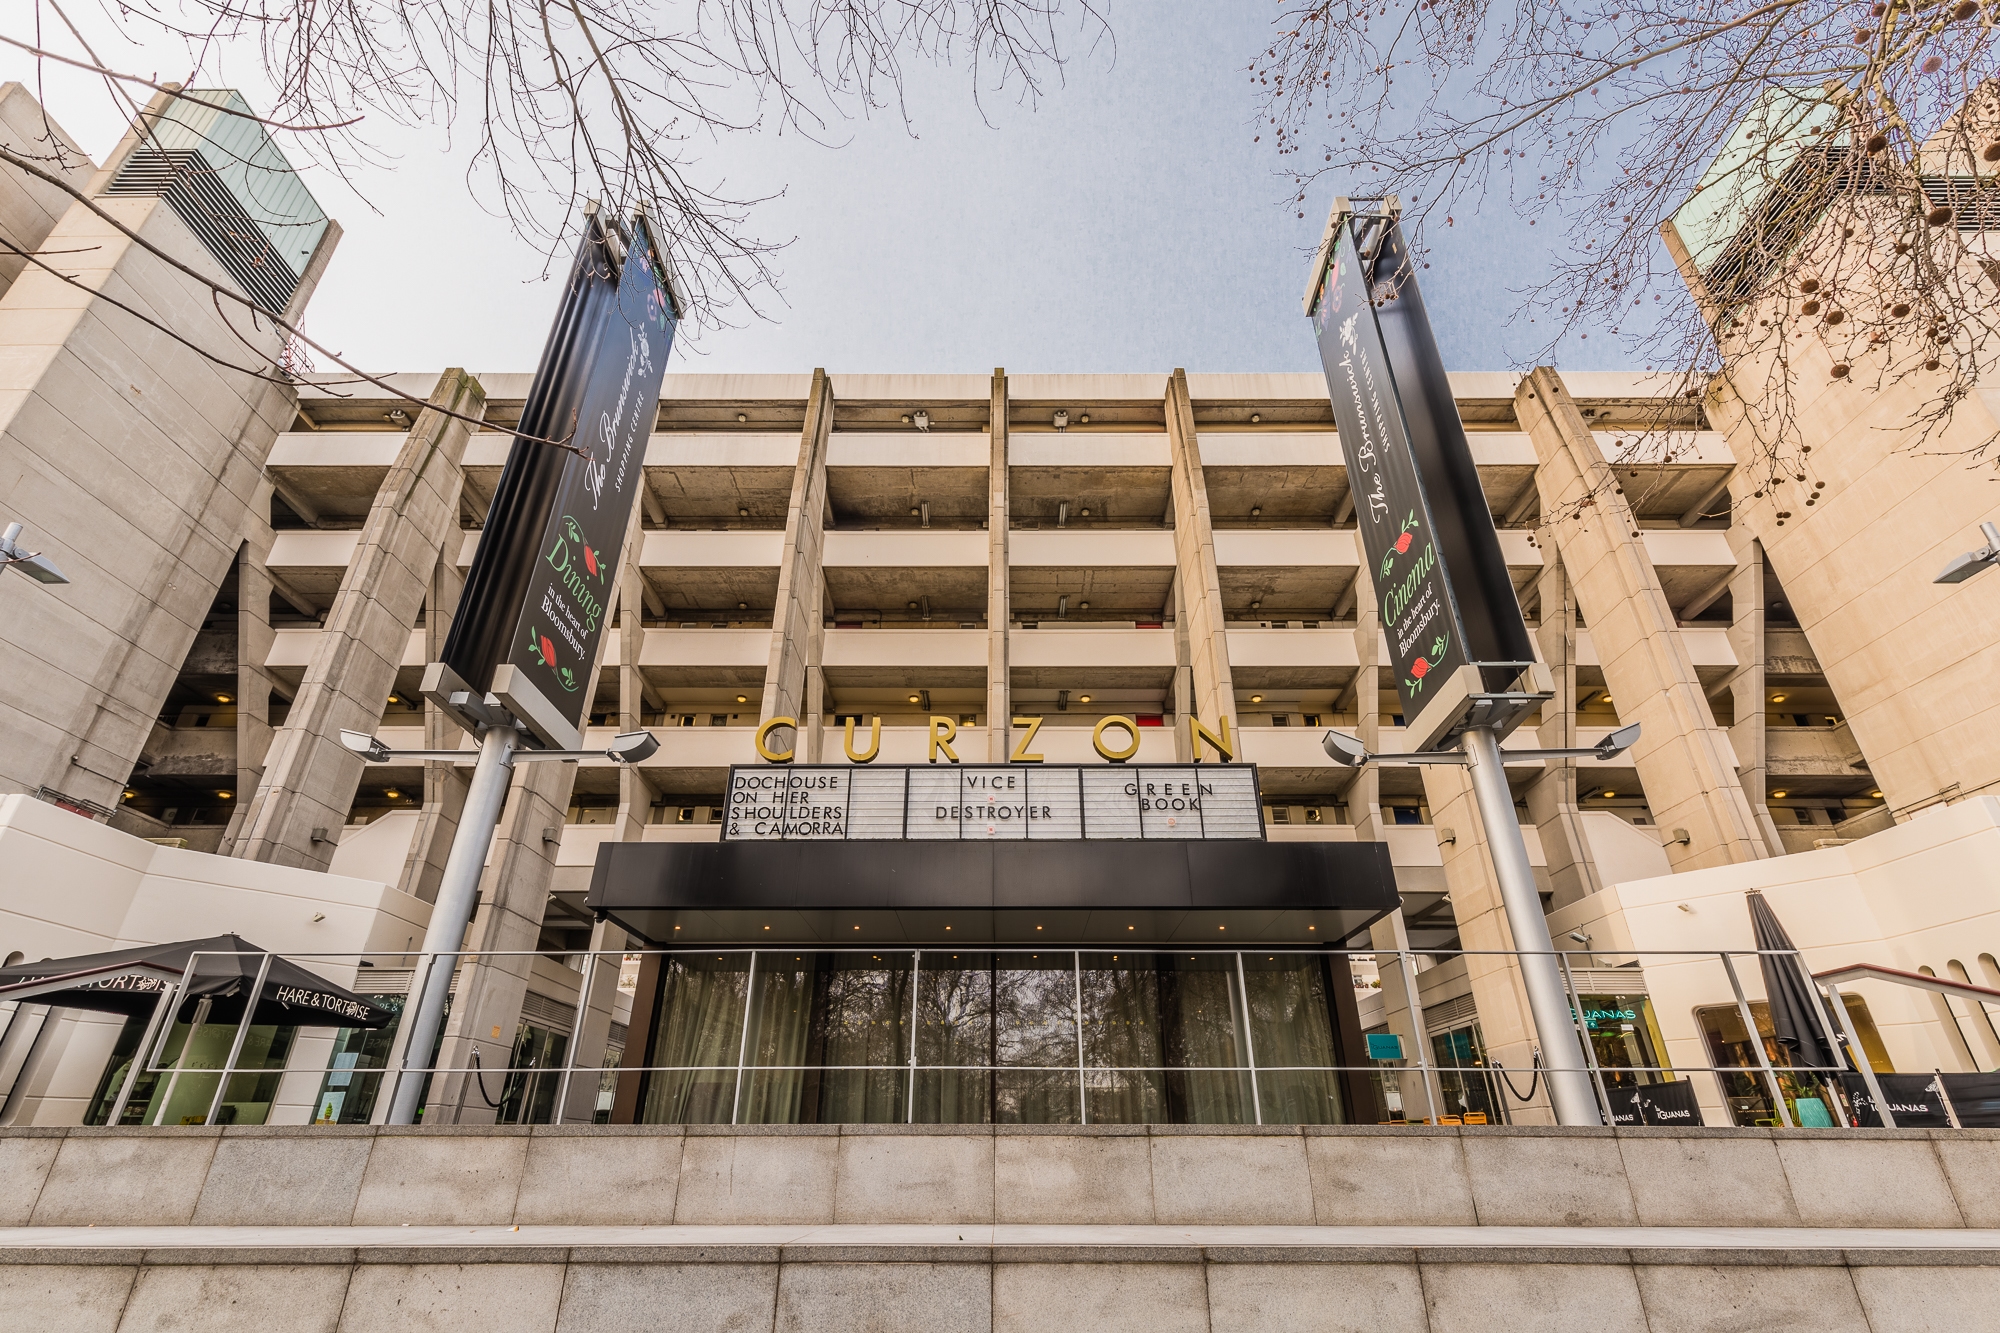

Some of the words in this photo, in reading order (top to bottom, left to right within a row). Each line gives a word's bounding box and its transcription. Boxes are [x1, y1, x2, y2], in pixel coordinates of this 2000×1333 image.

[1359, 346, 1374, 391] CENTRE
[584, 451, 606, 510] The
[600, 326, 638, 463] Brunswick
[1339, 350, 1377, 473] Brunswick
[1371, 392, 1390, 453] SHOPPING
[615, 434, 634, 493] SHOPPING
[630, 390, 645, 432] CENTRE
[1367, 472, 1389, 524] The
[545, 533, 602, 632] Dining
[1384, 541, 1434, 627] Cinema
[541, 595, 586, 660] Bloomsbury.
[547, 583, 555, 597] in
[555, 594, 566, 612] the
[565, 605, 582, 632] heart
[580, 629, 589, 640] of
[1396, 628, 1404, 640] in
[1403, 616, 1412, 632] the
[1411, 595, 1426, 620] heart
[1425, 582, 1433, 599] of
[1398, 598, 1440, 658] Bloomsbury.
[755, 714, 1234, 764] CURZON
[732, 791, 758, 804] ON
[772, 791, 809, 804] HER
[734, 776, 838, 789] DOCHOUSE
[967, 776, 1016, 789] VICE
[1124, 783, 1213, 796] GREEN
[1141, 798, 1200, 811] BOOK
[729, 822, 740, 836] &
[754, 821, 844, 836] CAMORRA
[731, 806, 842, 820] SHOULDERS
[935, 806, 1052, 819] DESTROYER
[276, 985, 312, 1005] HARE
[310, 993, 320, 1007] &
[1657, 1109, 1690, 1120] IGUANAS
